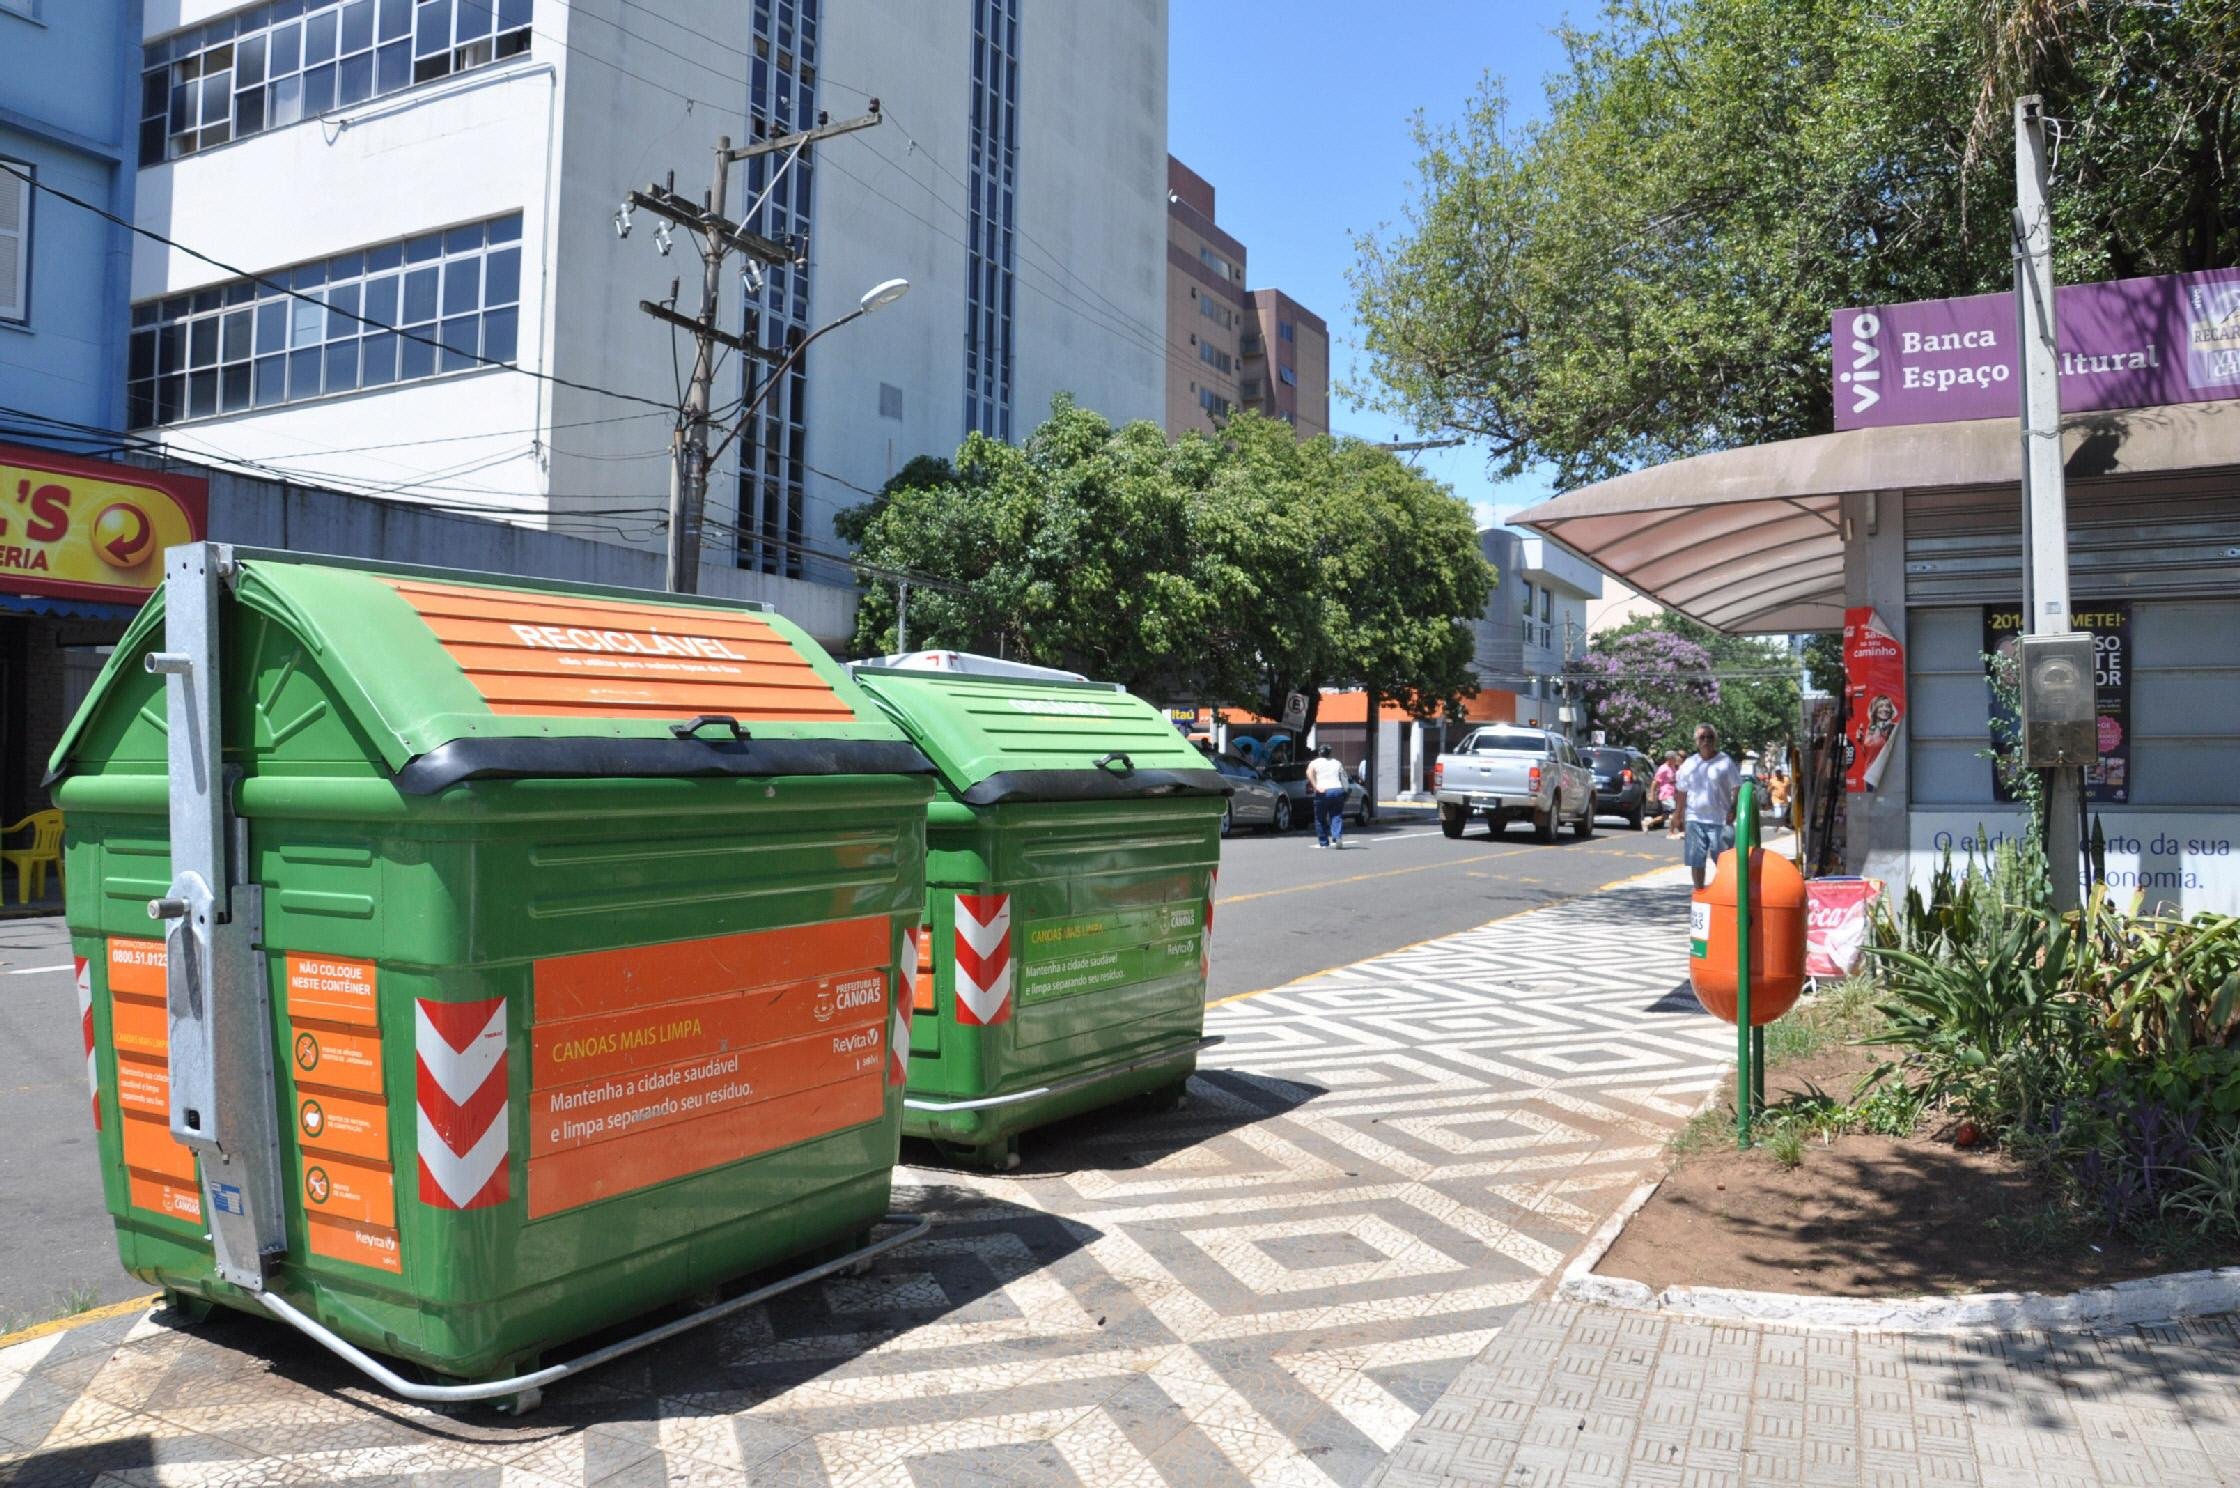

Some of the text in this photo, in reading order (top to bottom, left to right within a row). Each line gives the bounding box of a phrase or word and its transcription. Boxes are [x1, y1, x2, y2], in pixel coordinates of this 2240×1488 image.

[1902, 329, 1997, 354] Banca
[1840, 313, 1880, 413] vivo
[1902, 345, 2160, 392] Espaço ltural
[0, 479, 71, 542] 'S
[2070, 612, 2121, 628] METE!
[510, 624, 747, 660] RECICLÁVEL
[2150, 832, 2178, 855] da
[2188, 839, 2230, 856] sua
[299, 960, 363, 980] NÃO COLOQUE
[1026, 962, 1060, 978] Mantenha
[291, 975, 371, 996] NESTE CONTÊINER
[836, 987, 881, 1010] CANOAS
[552, 1018, 702, 1063] CANOAS MAIS LIMPA
[550, 1054, 739, 1112] Mantenha a cidade saudável
[550, 1080, 754, 1143] e limpa separando seu resíduo.
